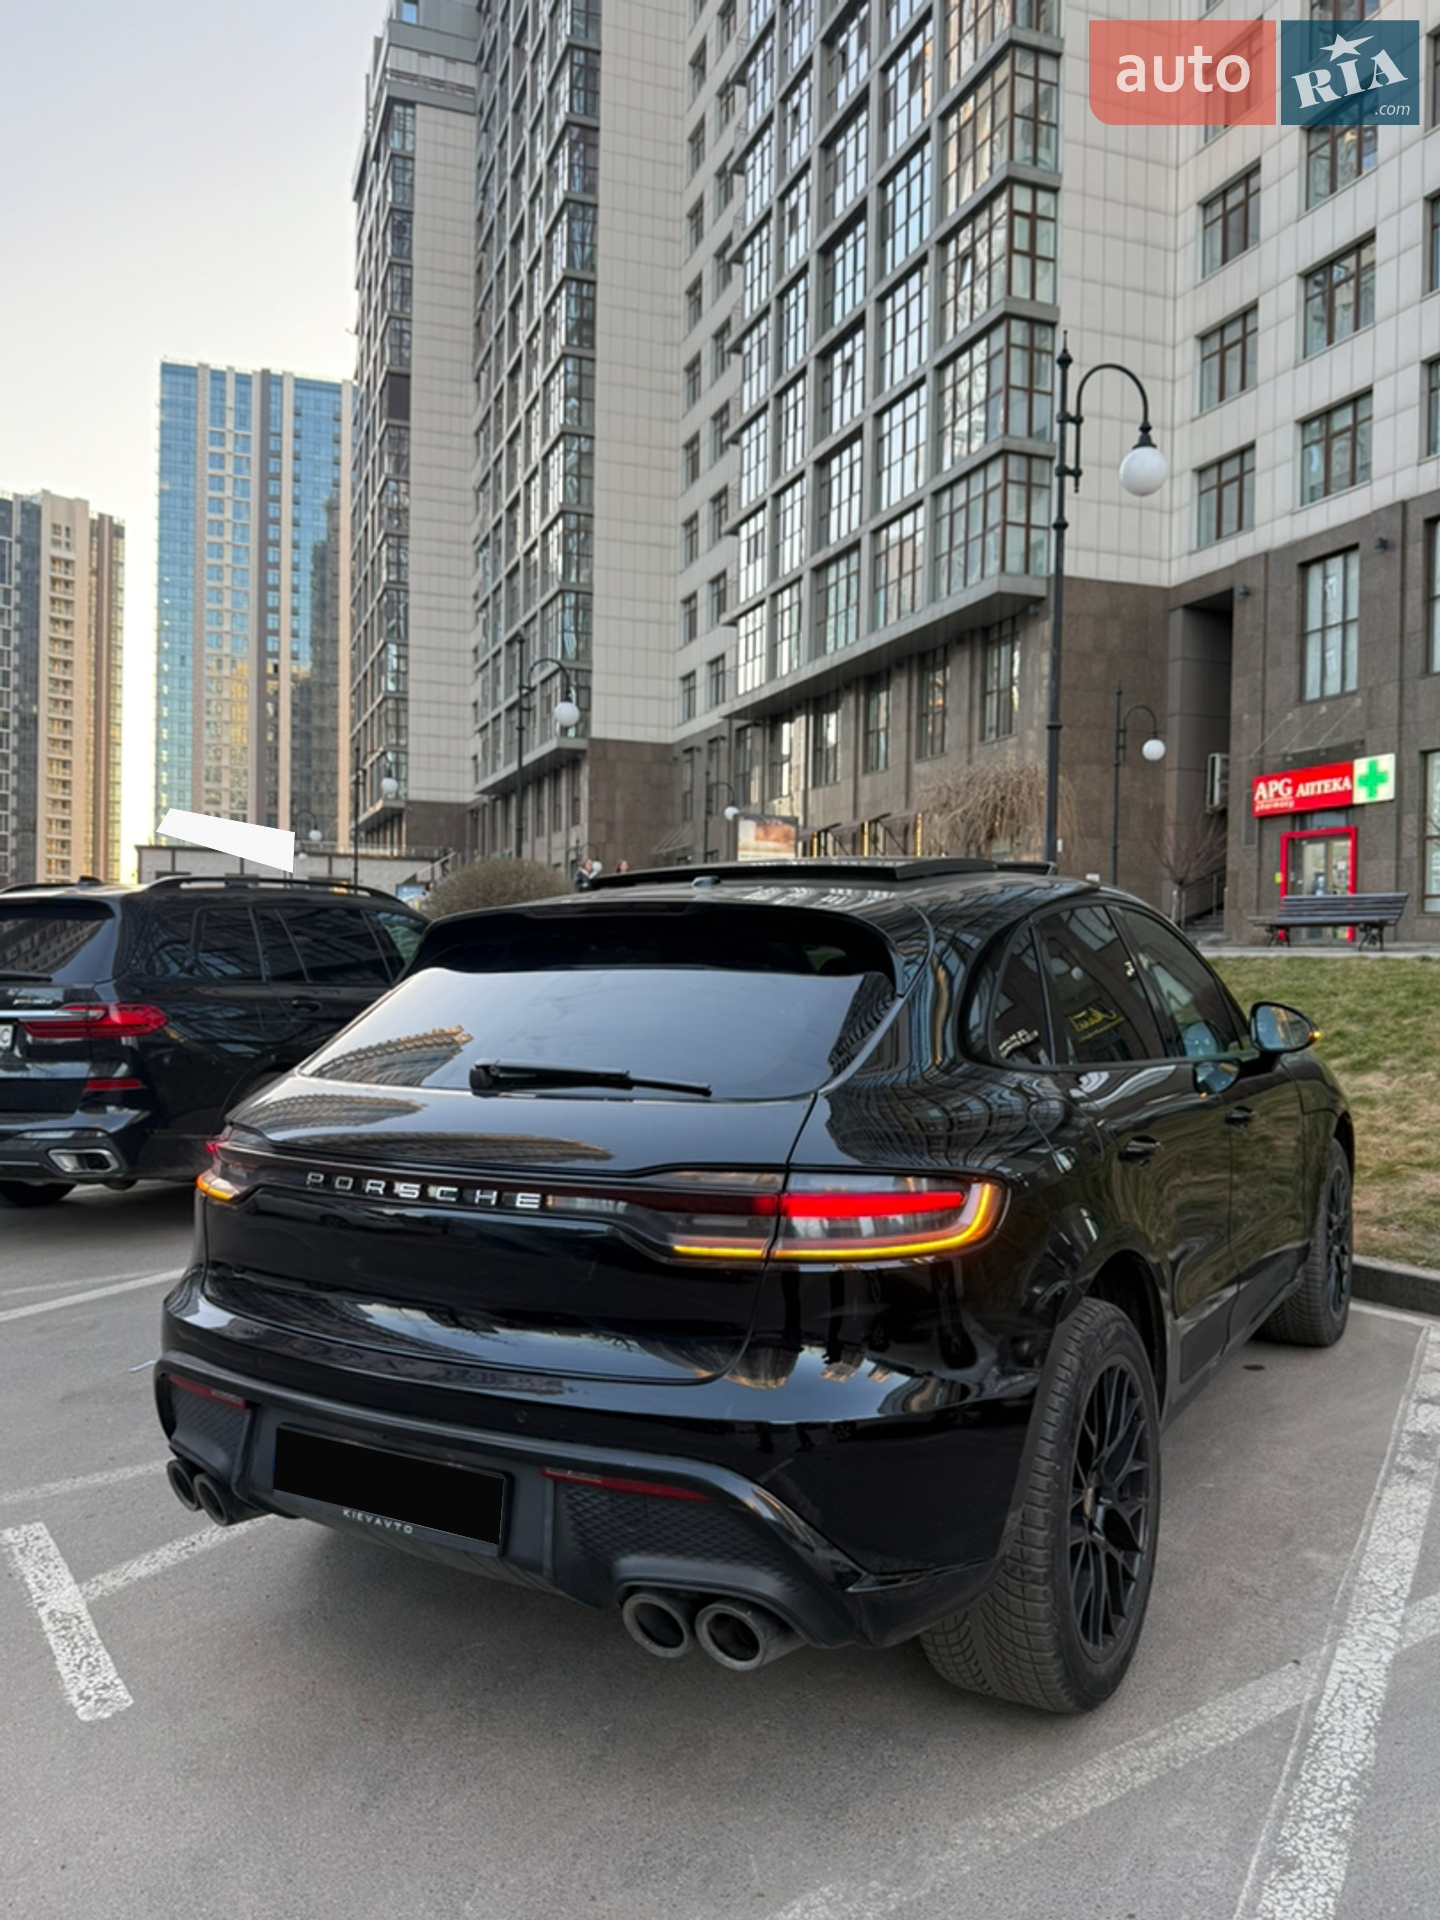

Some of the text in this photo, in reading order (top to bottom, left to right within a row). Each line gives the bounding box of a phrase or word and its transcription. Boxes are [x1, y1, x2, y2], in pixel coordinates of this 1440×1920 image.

[1254, 776, 1352, 801] APG АПТЕКА
[306, 1172, 542, 1208] PORSCHE
